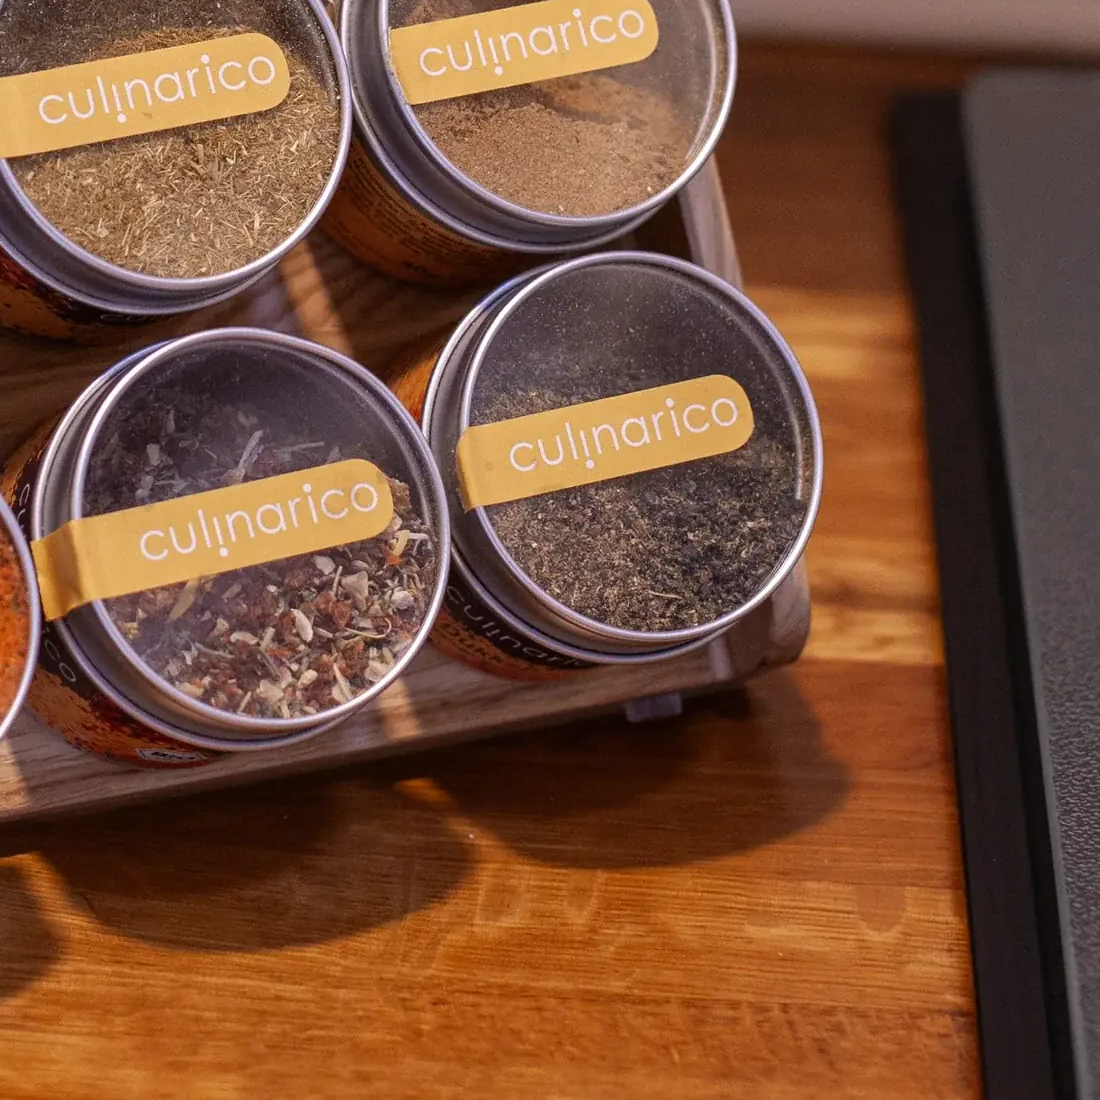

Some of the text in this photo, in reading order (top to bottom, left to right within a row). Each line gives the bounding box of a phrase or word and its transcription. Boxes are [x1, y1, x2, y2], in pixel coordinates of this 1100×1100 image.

[419, 7, 645, 77] culinarico
[38, 53, 276, 125] culinarico
[509, 397, 739, 472] culinarico
[139, 482, 379, 561] culinarico
